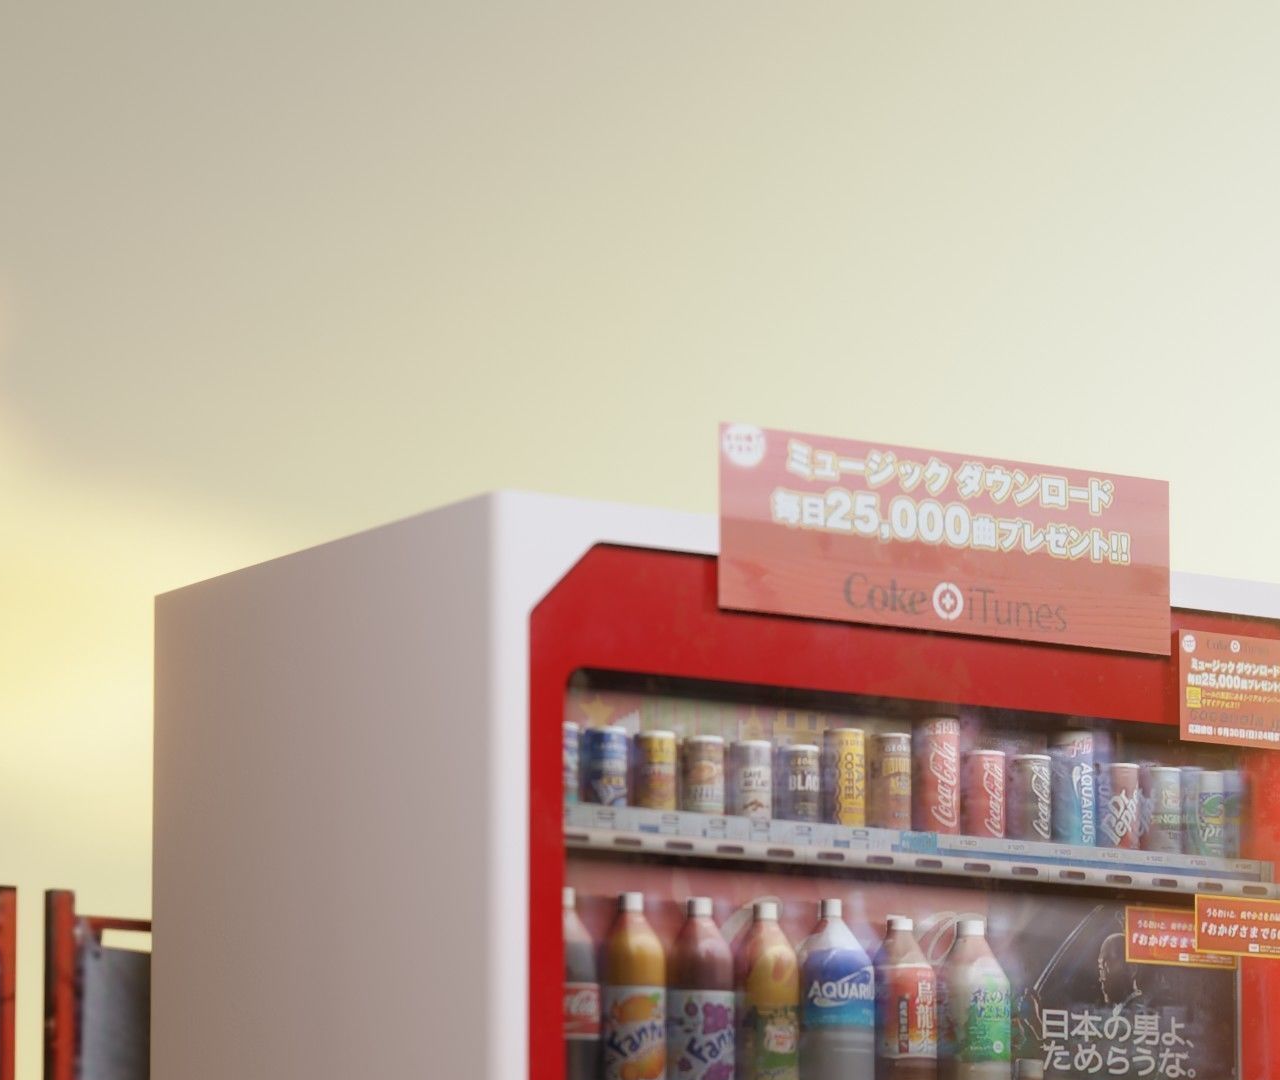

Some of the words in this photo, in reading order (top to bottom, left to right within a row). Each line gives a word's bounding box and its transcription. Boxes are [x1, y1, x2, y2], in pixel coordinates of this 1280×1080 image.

[842, 571, 928, 617] Coke
[967, 586, 1069, 633] iTunes
[1080, 762, 1097, 845] AQUARIUS
[1040, 1008, 1195, 1048] 日本の男よ、
[1040, 1040, 1197, 1080] ためらうな。
